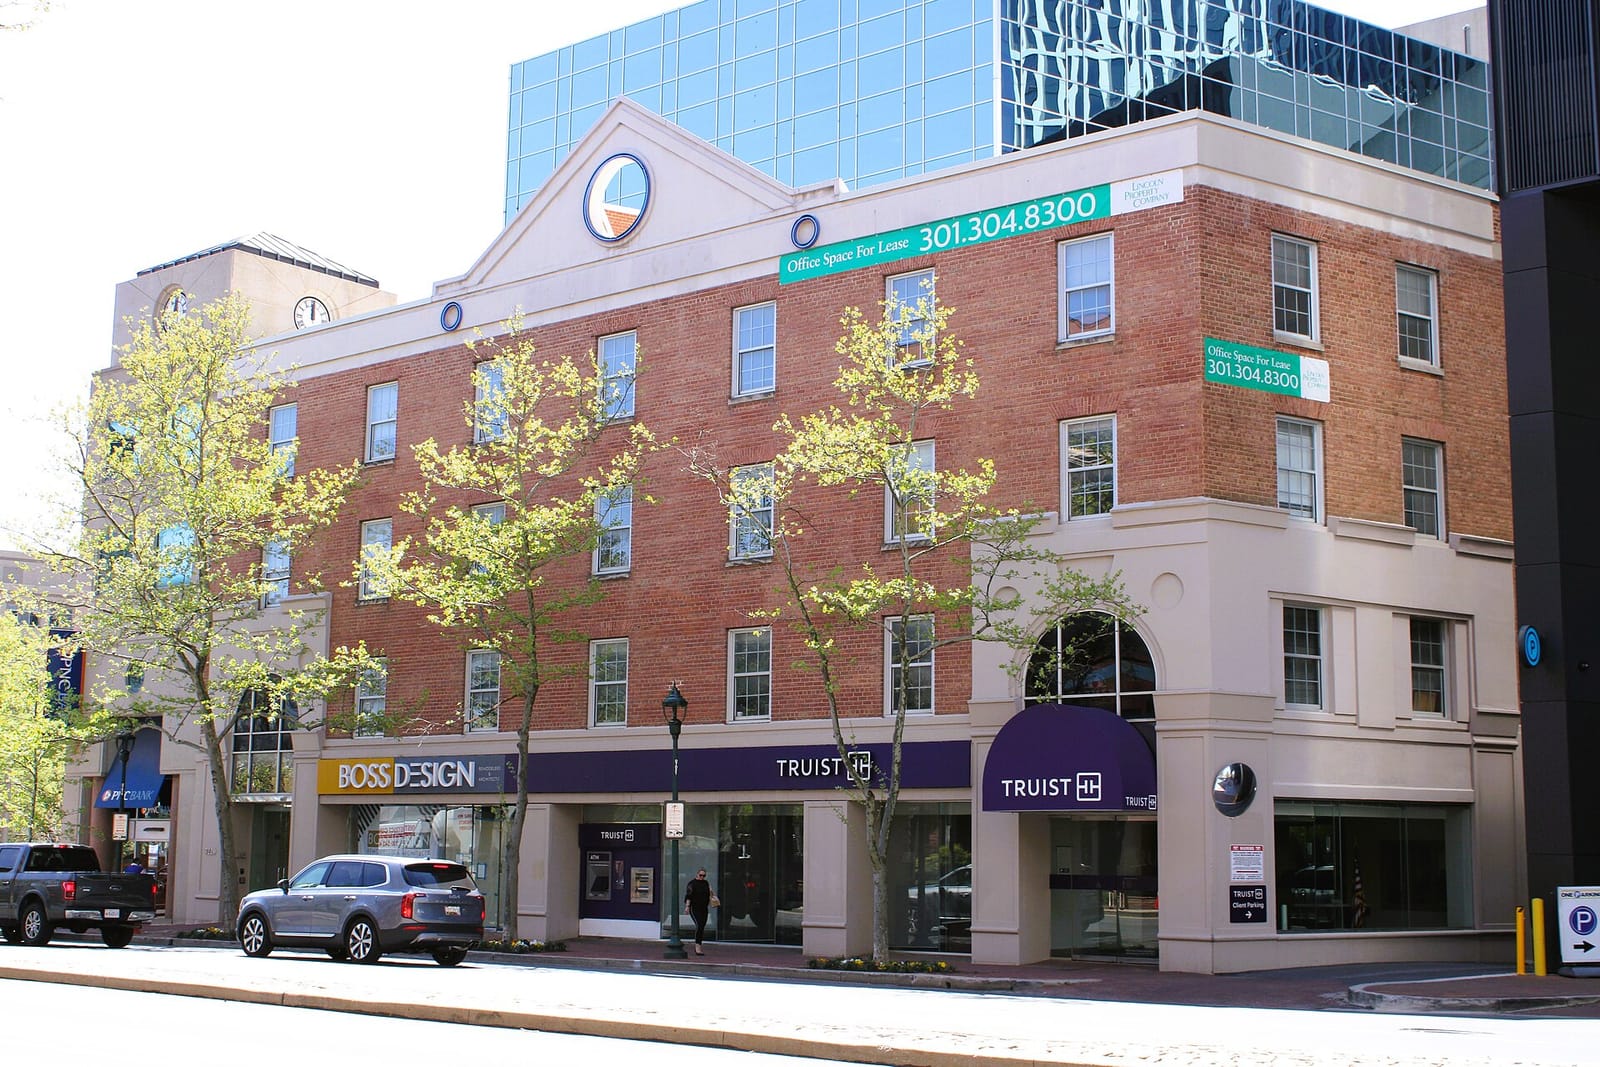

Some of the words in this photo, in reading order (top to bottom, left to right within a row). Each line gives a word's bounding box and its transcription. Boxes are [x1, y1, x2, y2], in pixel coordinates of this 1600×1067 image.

[787, 257, 821, 273] Office
[823, 249, 854, 267] Space
[856, 244, 875, 259] For
[878, 238, 910, 253] Lease
[919, 192, 1096, 251] 301.304.8300
[1208, 345, 1232, 359] Office
[1233, 350, 1254, 364] Space
[1256, 355, 1270, 366] For
[1271, 357, 1291, 370] Lease
[1207, 359, 1299, 389] 301.304.8300
[338, 763, 392, 788] BOSS
[394, 761, 475, 788] DESIGN
[776, 758, 842, 777] TRUIST
[1001, 778, 1072, 797] TRUIST
[1125, 796, 1148, 807] TRUIST
[600, 831, 625, 840] TRUIST
[1233, 890, 1255, 898] TRUIST
